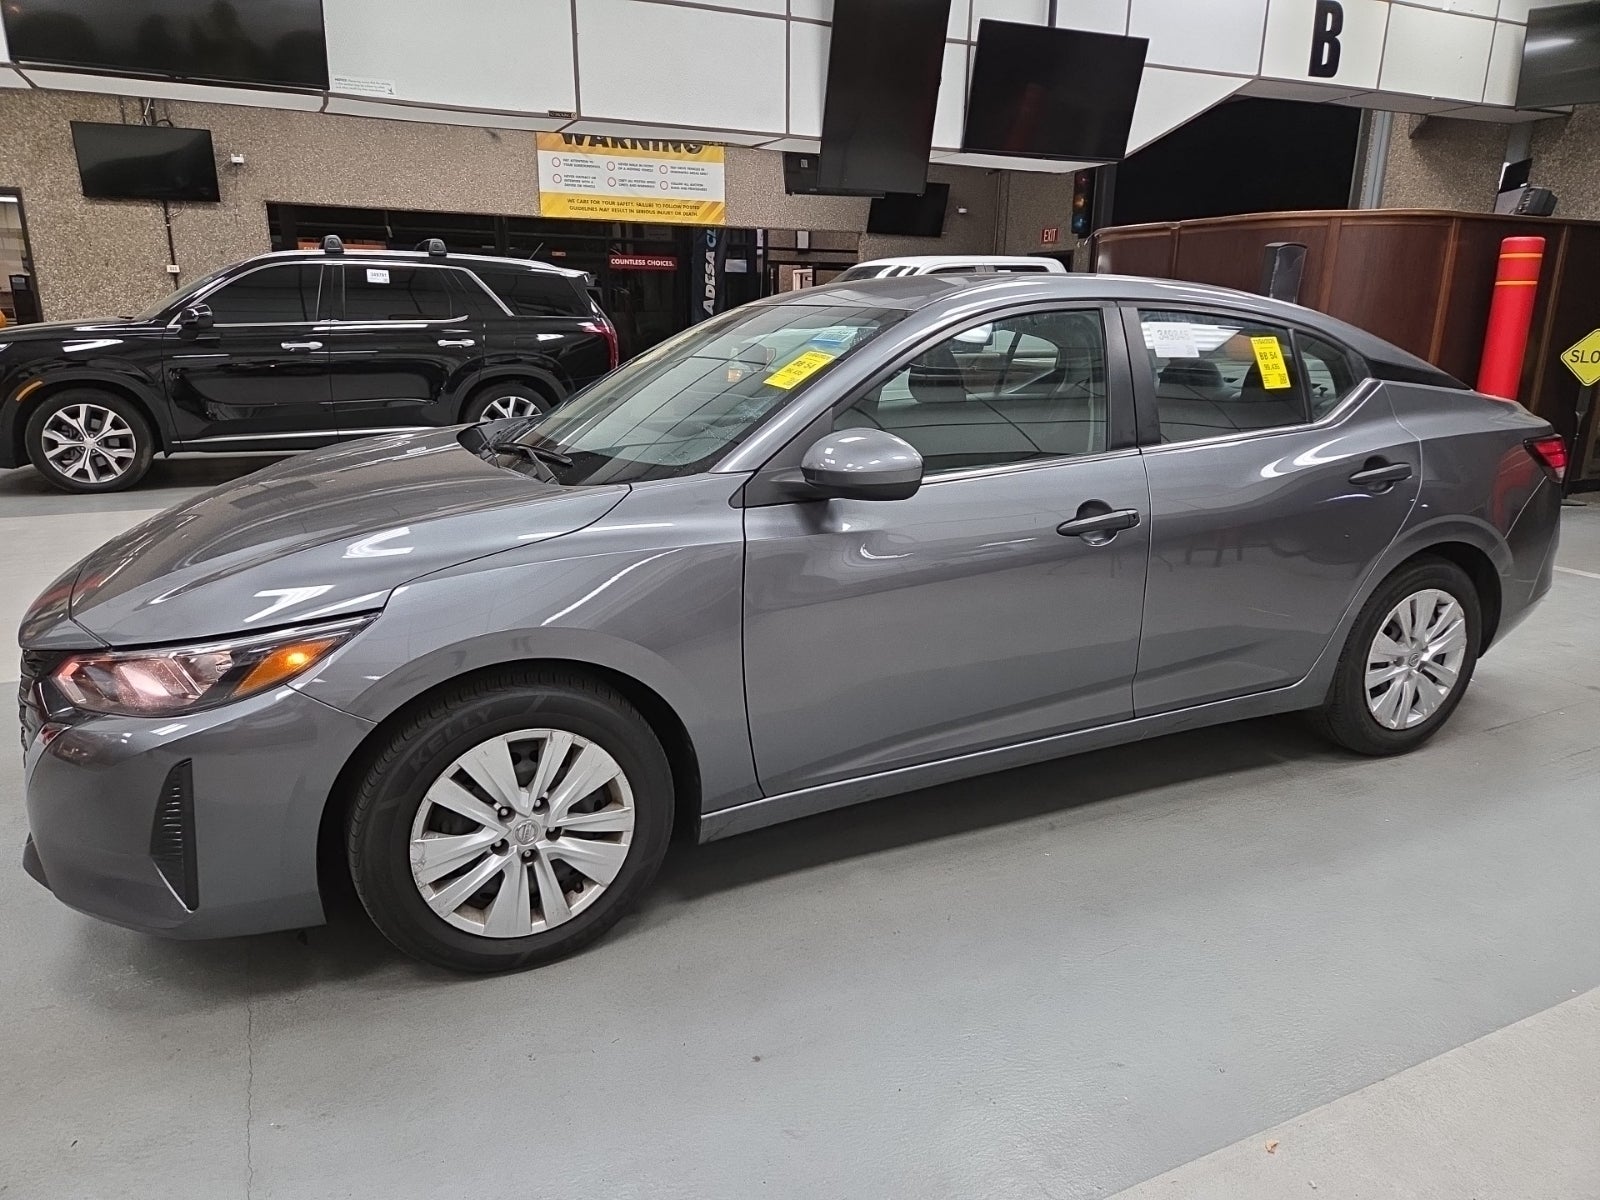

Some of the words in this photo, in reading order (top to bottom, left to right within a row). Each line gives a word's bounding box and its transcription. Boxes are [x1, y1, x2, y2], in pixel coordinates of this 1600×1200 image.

[1308, 0, 1343, 78] B
[1043, 228, 1057, 242] EXIT
[611, 258, 646, 266] COUNTLESS
[647, 259, 675, 267] CHOICES.
